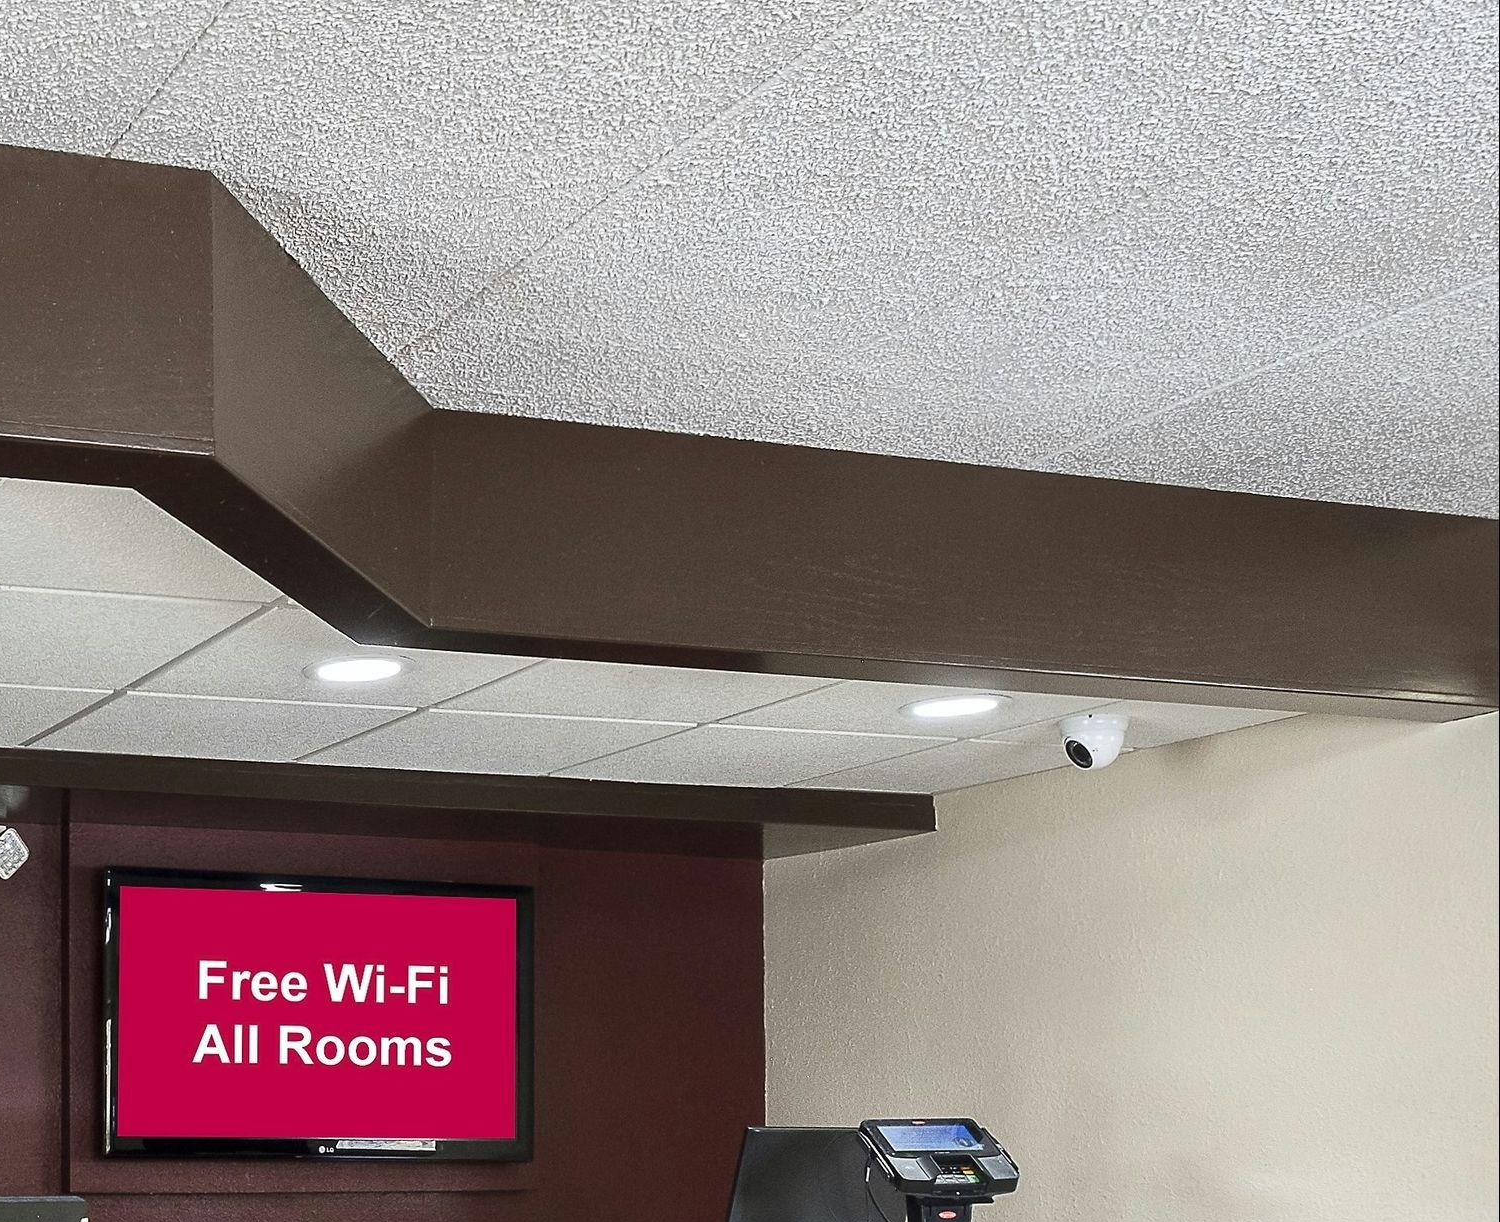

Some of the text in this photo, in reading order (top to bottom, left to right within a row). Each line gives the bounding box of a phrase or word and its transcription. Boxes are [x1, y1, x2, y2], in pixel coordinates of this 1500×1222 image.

[198, 959, 449, 1005] Free Wi-Fi
[192, 1023, 452, 1067] All Rooms
